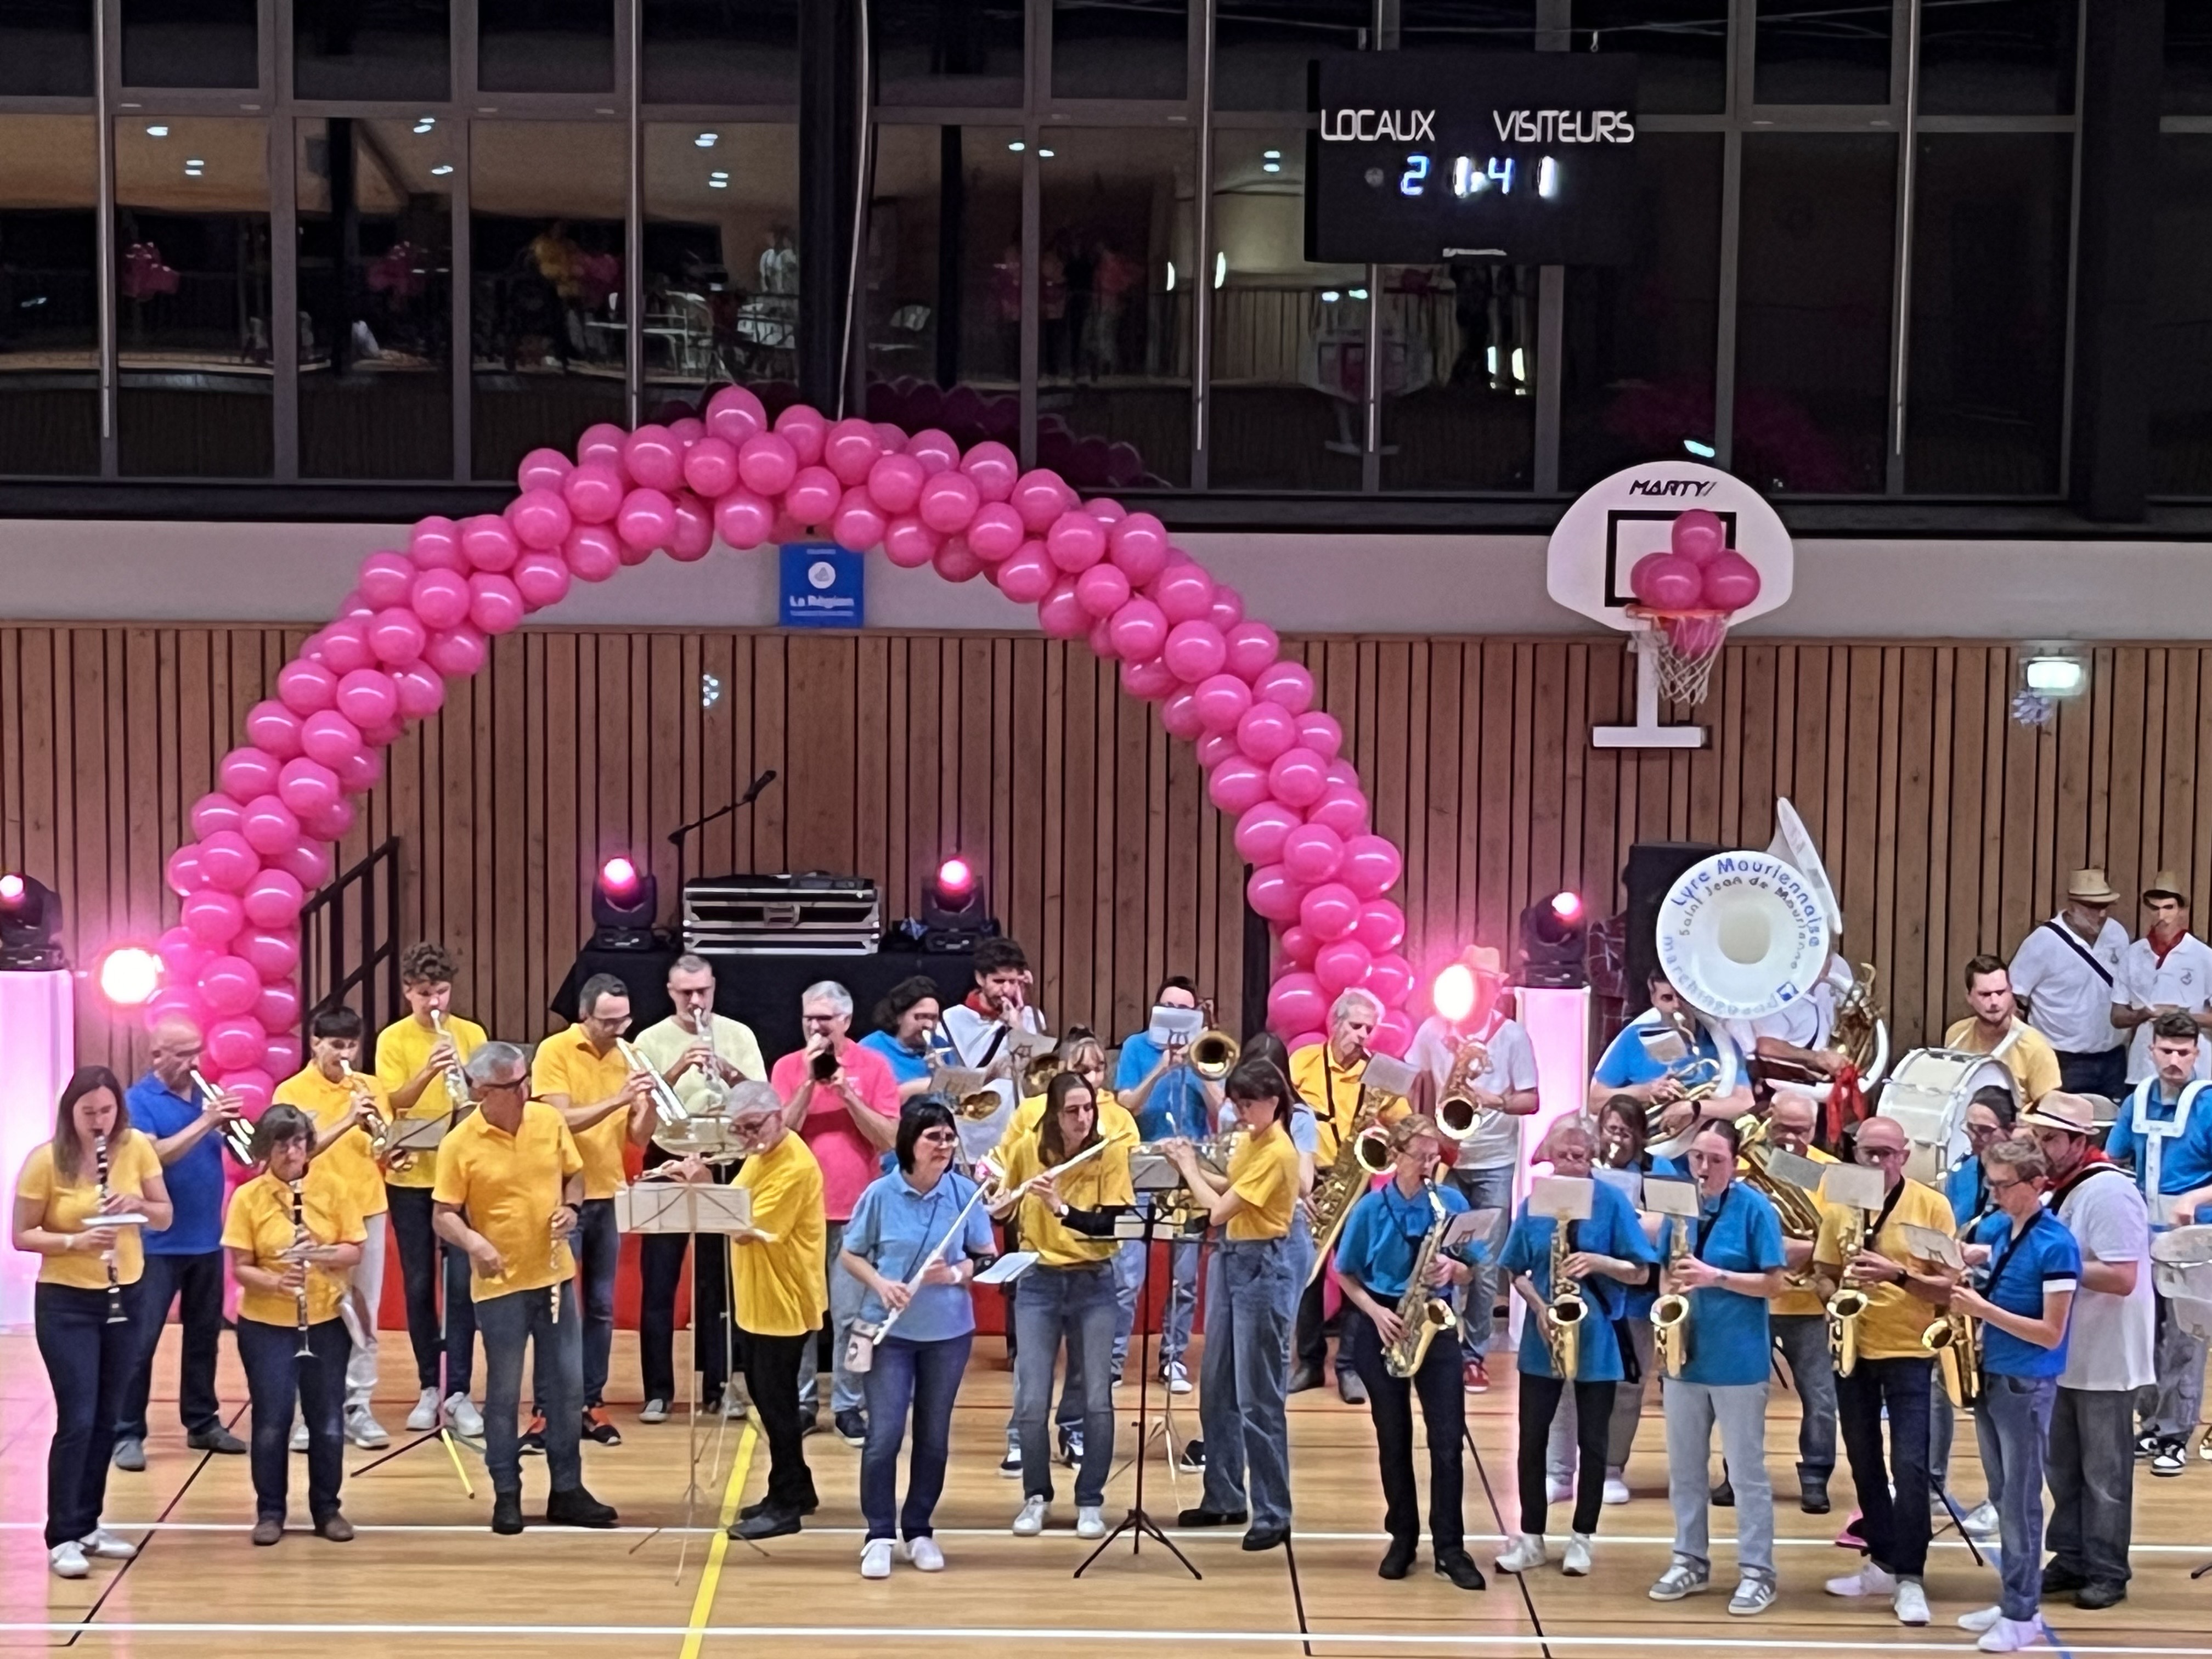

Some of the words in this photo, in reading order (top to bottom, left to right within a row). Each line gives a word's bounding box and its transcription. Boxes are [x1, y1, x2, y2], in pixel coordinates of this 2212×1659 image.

[1321, 109, 1436, 142] LOCAUX
[1492, 109, 1635, 143] VISITEURS
[1748, 876, 1769, 889] de
